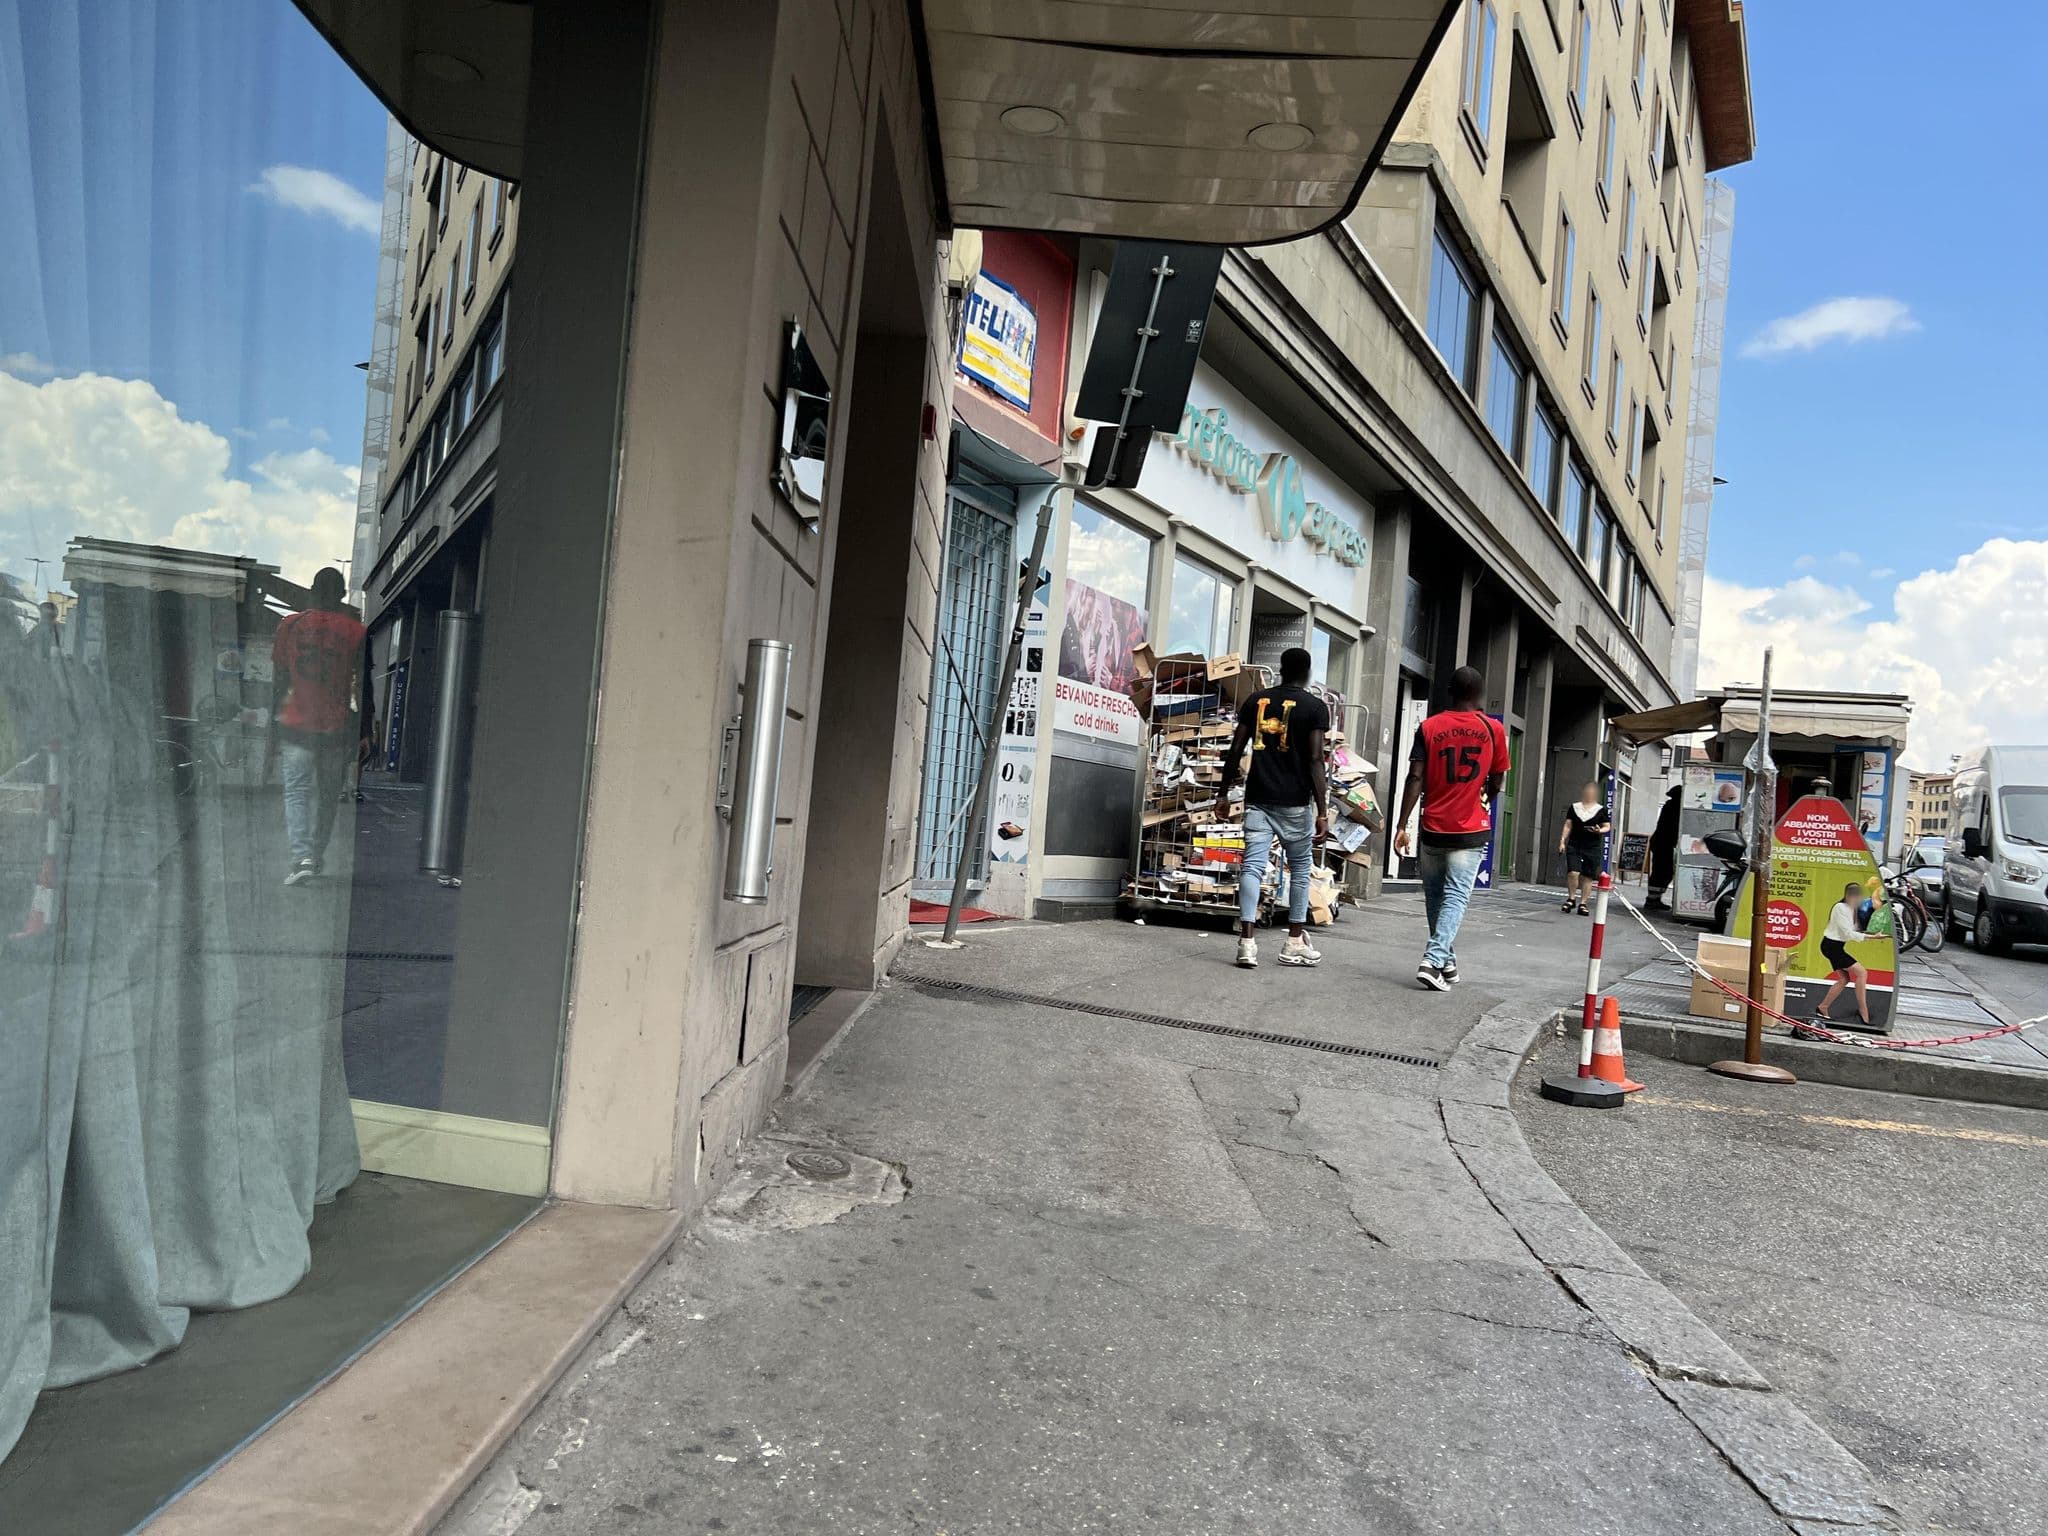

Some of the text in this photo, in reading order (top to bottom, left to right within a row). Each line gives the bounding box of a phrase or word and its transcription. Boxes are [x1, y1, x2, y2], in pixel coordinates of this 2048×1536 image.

[1256, 626, 1304, 637] Welcome
[1056, 683, 1137, 718] BEVANDE FRESCHE
[1074, 712, 1119, 734] cold drinks
[1439, 746, 1482, 784] 15
[1806, 814, 1829, 822] NON
[1784, 821, 1851, 832] ABBANDONATE
[1802, 829, 1836, 838] VOSTRI
[1790, 836, 1842, 847] SACCHETTI
[1779, 854, 1807, 862] CESTINI
[1809, 855, 1816, 863] O
[1817, 856, 1833, 864] PER
[1833, 857, 1868, 867] STRADA!
[1777, 877, 1812, 885] COGLIERE
[1767, 915, 1800, 927] 500 €
